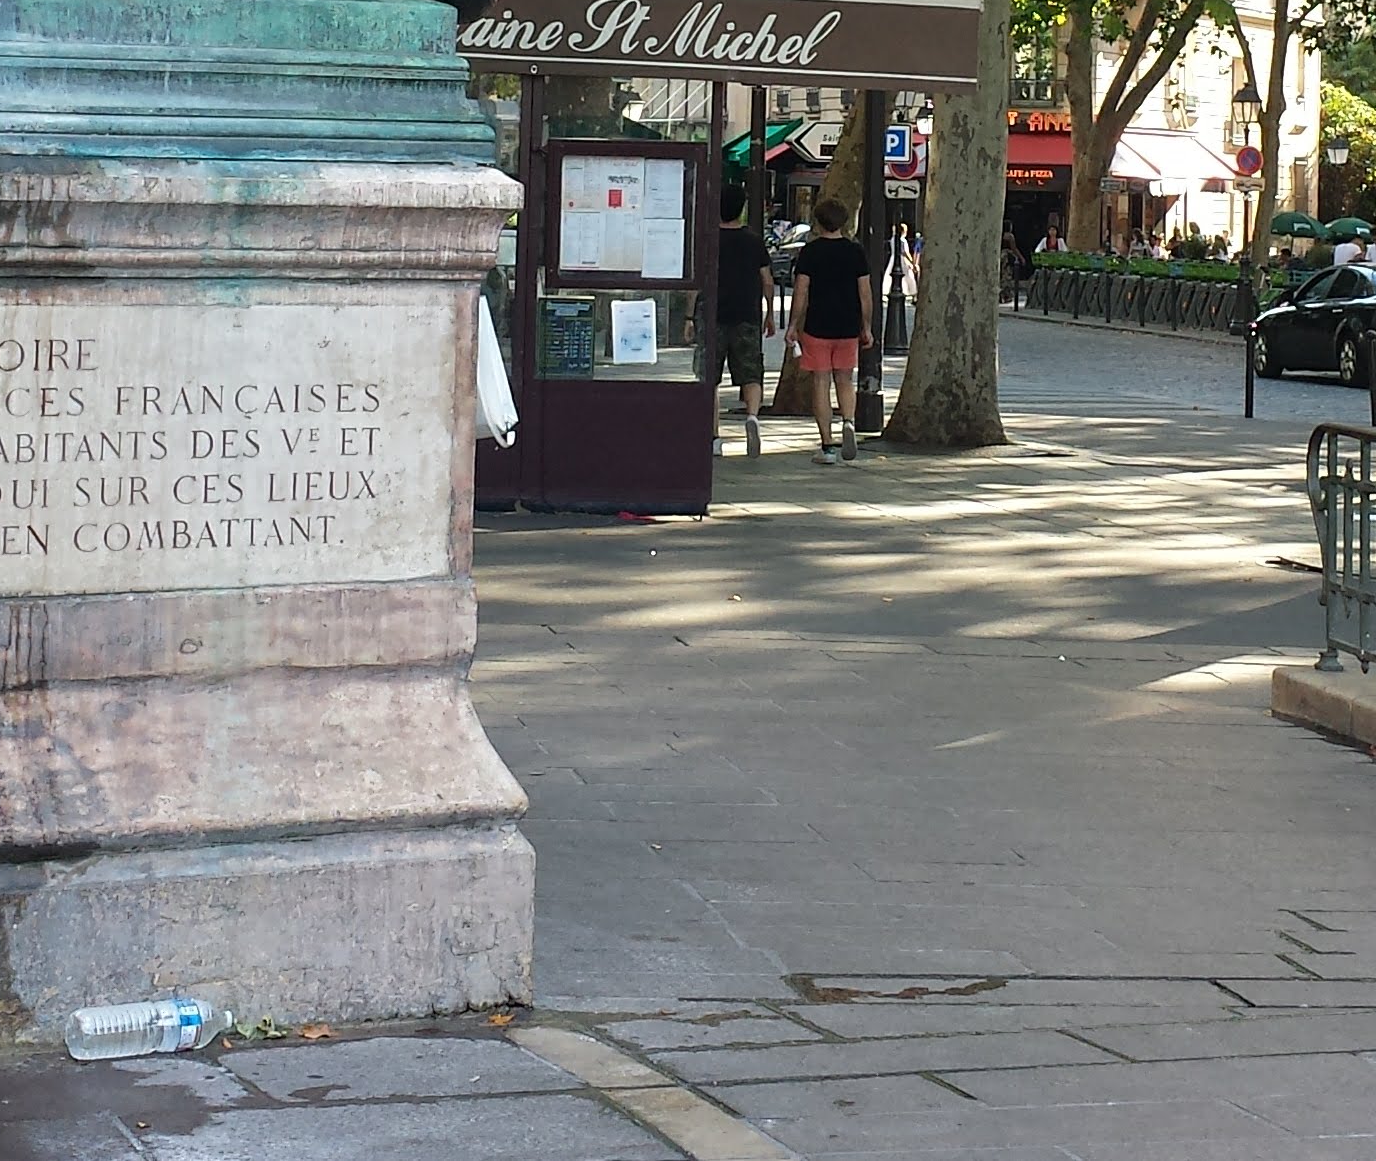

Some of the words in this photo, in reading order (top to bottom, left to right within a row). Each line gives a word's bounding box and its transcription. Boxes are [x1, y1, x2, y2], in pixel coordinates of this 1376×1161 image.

[456, 9, 564, 51] aine
[645, 1, 842, 66] Michel
[886, 134, 900, 153] P
[116, 384, 381, 420] FRANÇAISES
[191, 428, 261, 460] DES
[341, 427, 380, 457] ET
[74, 476, 150, 508] SUR
[173, 474, 243, 506] CES
[268, 470, 377, 502] LIEUX
[2, 523, 49, 556] EN
[74, 516, 344, 553] COMBATTANT.
